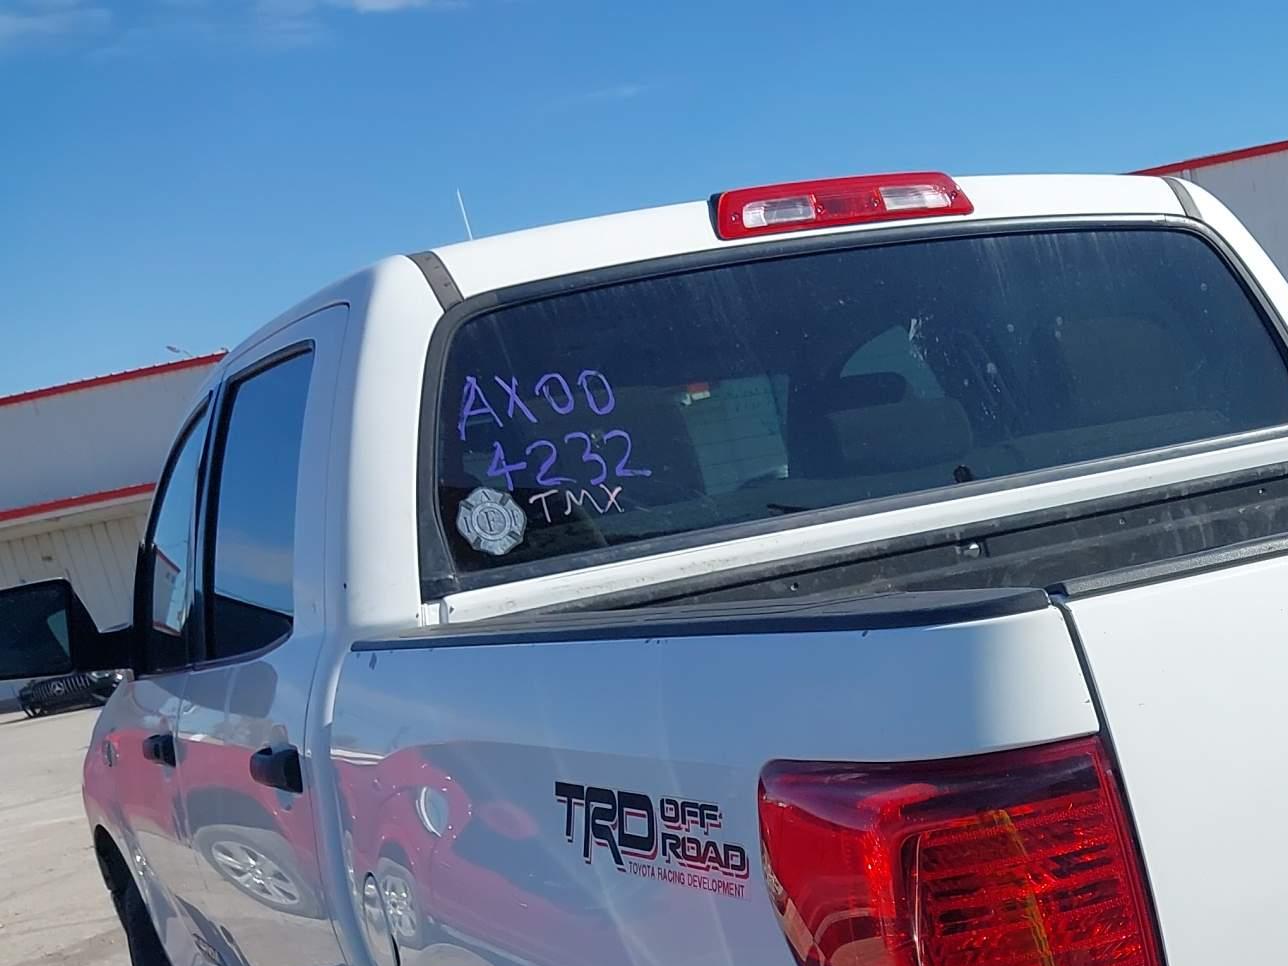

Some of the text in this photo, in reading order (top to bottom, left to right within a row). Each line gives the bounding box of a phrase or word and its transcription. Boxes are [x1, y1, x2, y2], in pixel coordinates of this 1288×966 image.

[487, 430, 652, 491] 4232
[529, 484, 624, 523] TMX
[555, 782, 657, 872] TRD
[660, 798, 723, 836] OFF
[661, 832, 750, 880] ROAD
[628, 860, 746, 898] TOYOTA RACING DEVELOPMENT
